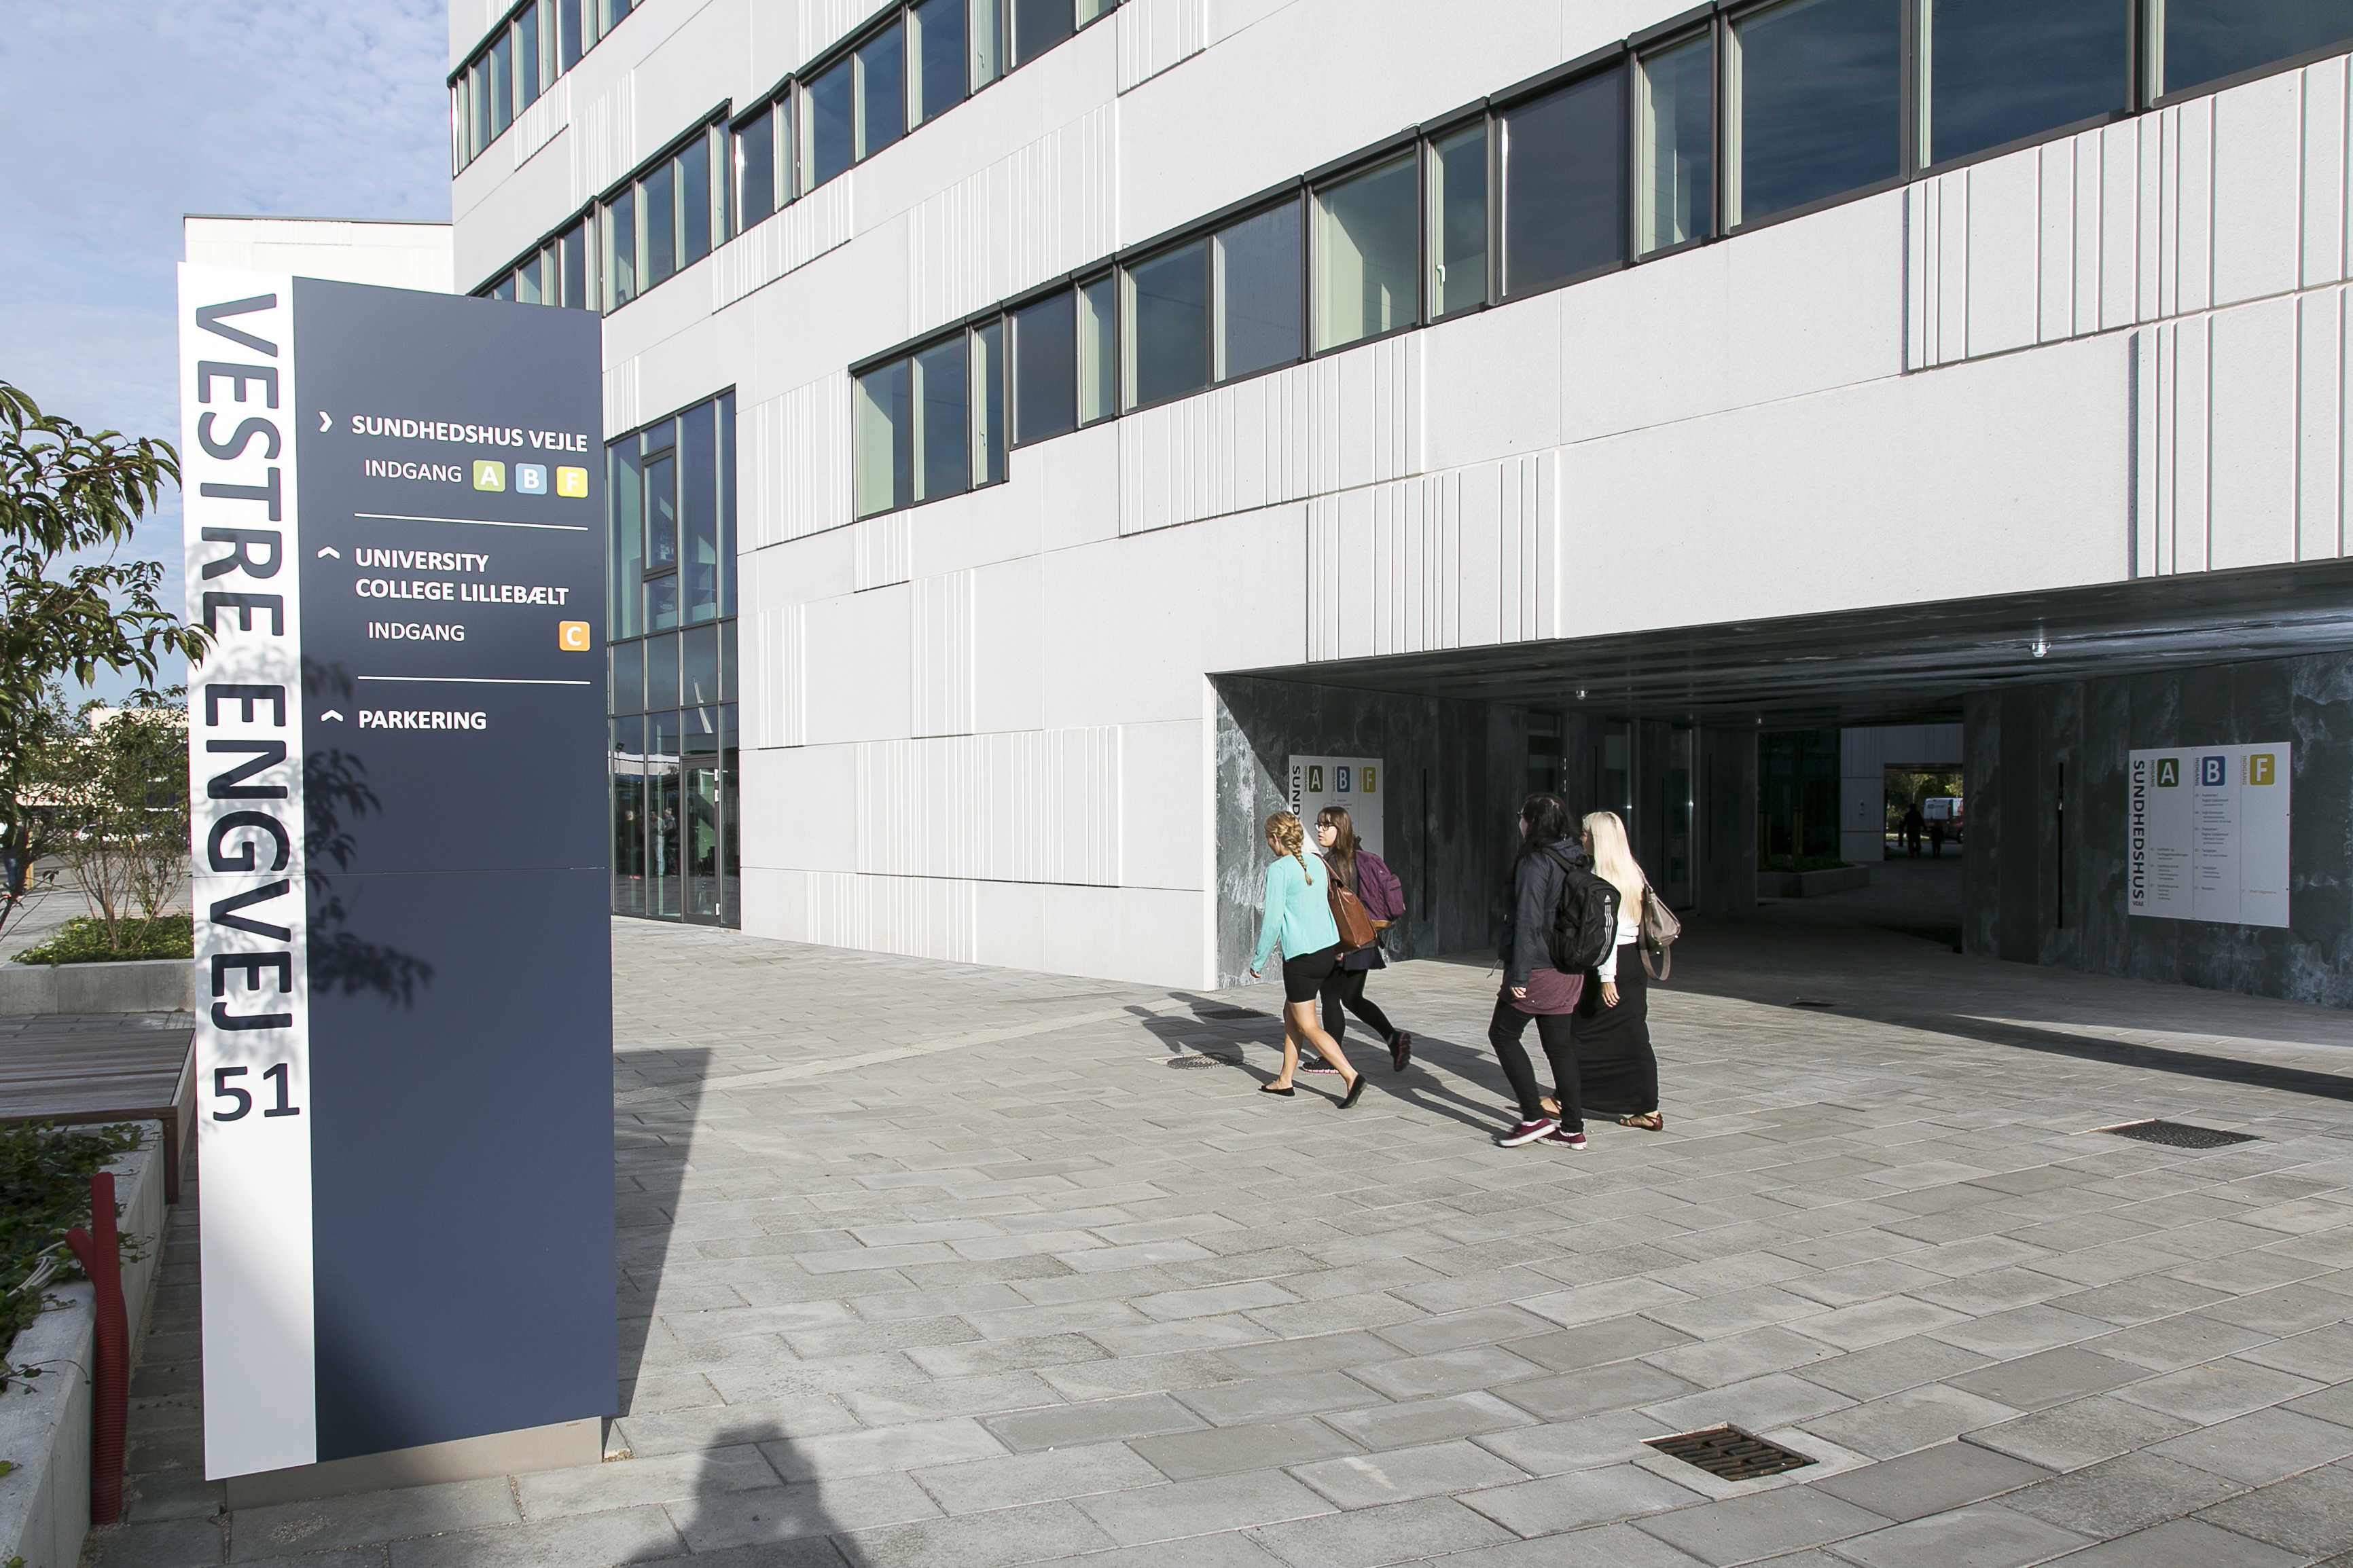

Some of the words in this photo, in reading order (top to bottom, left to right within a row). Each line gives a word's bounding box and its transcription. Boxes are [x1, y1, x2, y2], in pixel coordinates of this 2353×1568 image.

[352, 415, 524, 447] SUNDHEDSHUS
[528, 430, 588, 452] VEJLE
[196, 293, 285, 636] VESTRE
[365, 459, 462, 483] INDGANG
[479, 465, 499, 486] A
[524, 469, 539, 489] B
[565, 473, 580, 492] F
[356, 548, 489, 572] UNIVERSITY
[355, 578, 454, 600] COLLEGE
[461, 583, 569, 605] LILLEBÆLT
[369, 621, 465, 642] INDGANG
[567, 626, 582, 646] C
[359, 710, 486, 730] PARKERING
[1311, 769, 1321, 789] A
[1340, 769, 1348, 789] B
[1367, 770, 1372, 790] F
[2160, 762, 2175, 784] A
[2206, 760, 2220, 783] B
[2256, 758, 2268, 782] F
[2133, 760, 2145, 899] SUNDHEDSHUS
[205, 683, 293, 1032] ENGVEJ
[213, 1063, 301, 1122] 51
